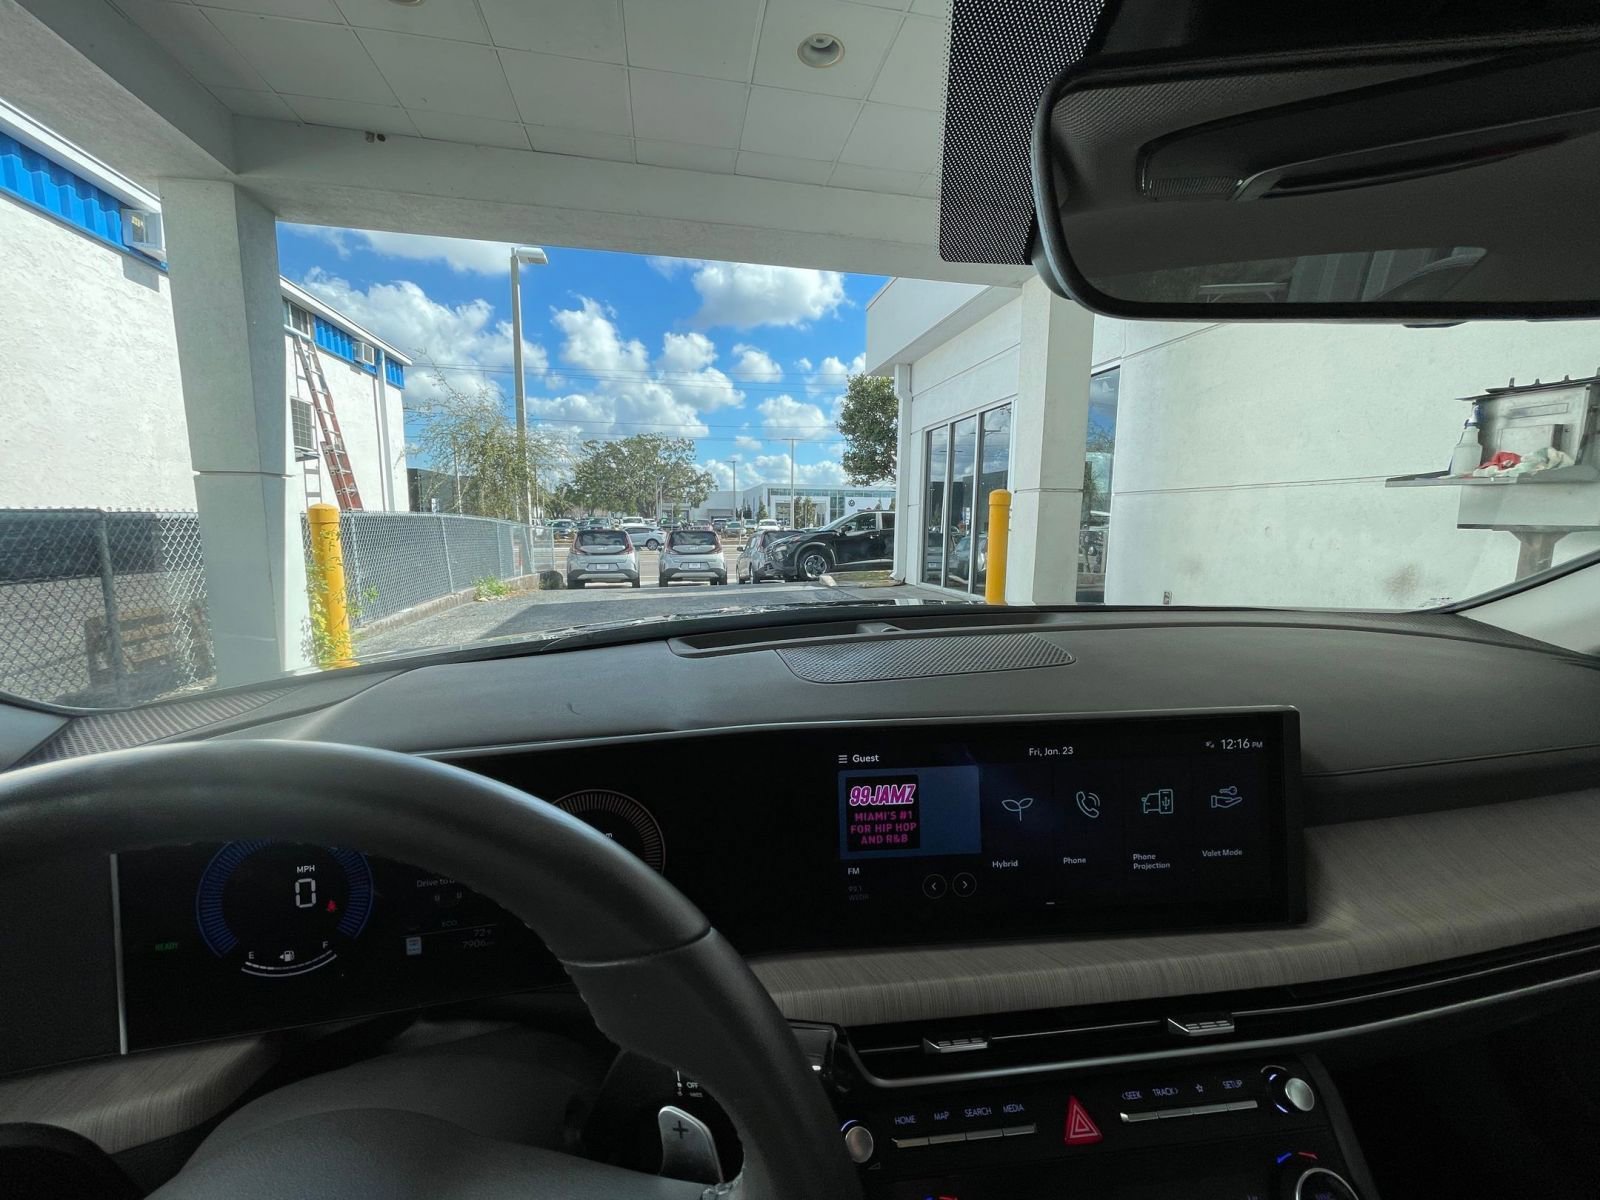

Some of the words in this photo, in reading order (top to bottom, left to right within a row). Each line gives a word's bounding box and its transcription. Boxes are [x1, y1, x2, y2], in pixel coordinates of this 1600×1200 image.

[1220, 739, 1250, 750] 12:16
[1251, 741, 1264, 749] PM
[1028, 747, 1043, 757] Fri,
[1044, 747, 1061, 757] Jan.
[1062, 746, 1074, 755] 23
[853, 754, 880, 763] Guest
[855, 811, 897, 822] MIAMI'S
[899, 810, 913, 820] #1
[850, 824, 871, 834] FOR
[875, 823, 893, 833] HIP
[895, 822, 918, 832] HOP
[860, 835, 884, 845] AND
[886, 833, 909, 844] R&B
[1132, 853, 1156, 861] Phone
[1202, 849, 1221, 857] Valet
[1222, 848, 1243, 856] Mode
[991, 859, 1019, 870] Hybrid
[1063, 856, 1087, 865] Phone
[296, 865, 316, 873] MPH
[848, 867, 860, 875] FM
[1133, 862, 1171, 871] Projection
[295, 878, 316, 908] 0
[322, 940, 329, 949] F
[248, 951, 255, 960] E
[1222, 1079, 1243, 1089] SETUP
[964, 1106, 992, 1118] SEARCH
[1003, 1103, 1025, 1113] MEDIA
[894, 1115, 917, 1125] HOME
[933, 1111, 950, 1121] MAP
